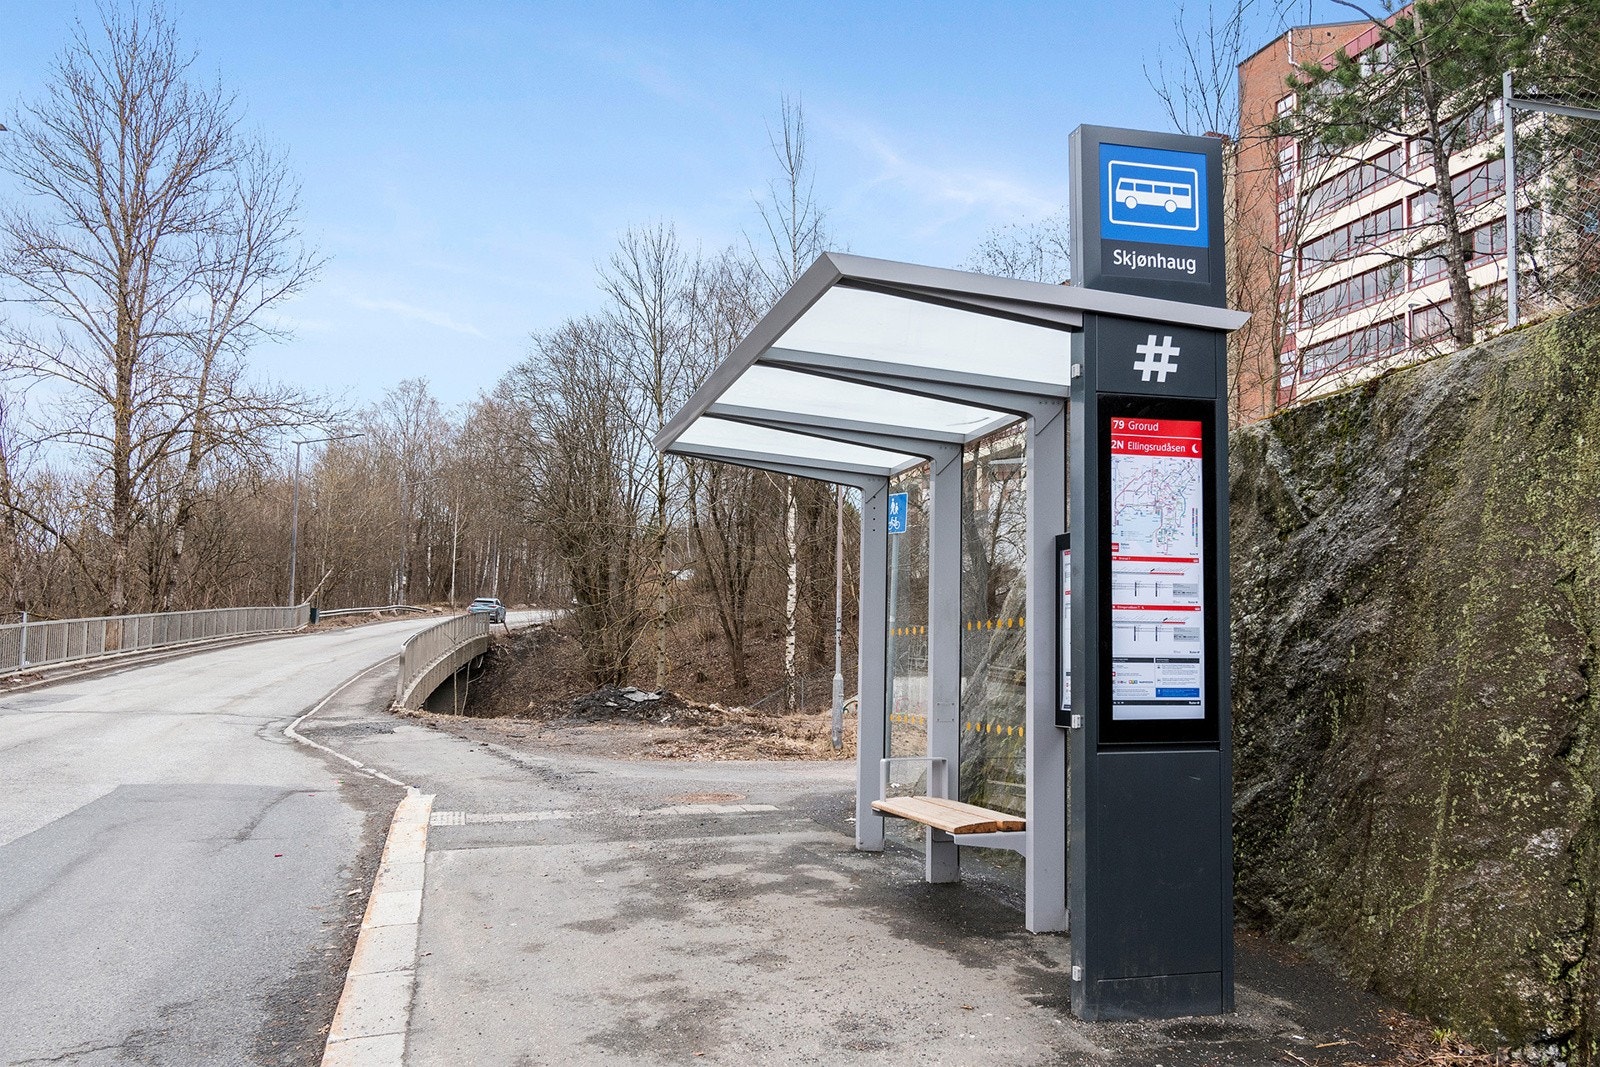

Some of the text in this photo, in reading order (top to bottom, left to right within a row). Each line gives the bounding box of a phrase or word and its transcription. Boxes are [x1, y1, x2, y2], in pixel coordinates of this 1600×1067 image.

[1113, 249, 1197, 275] Skjønhaug
[1113, 420, 1159, 431] 79 Grorud
[1111, 440, 1186, 452] 2N Ellingsrudåsen
